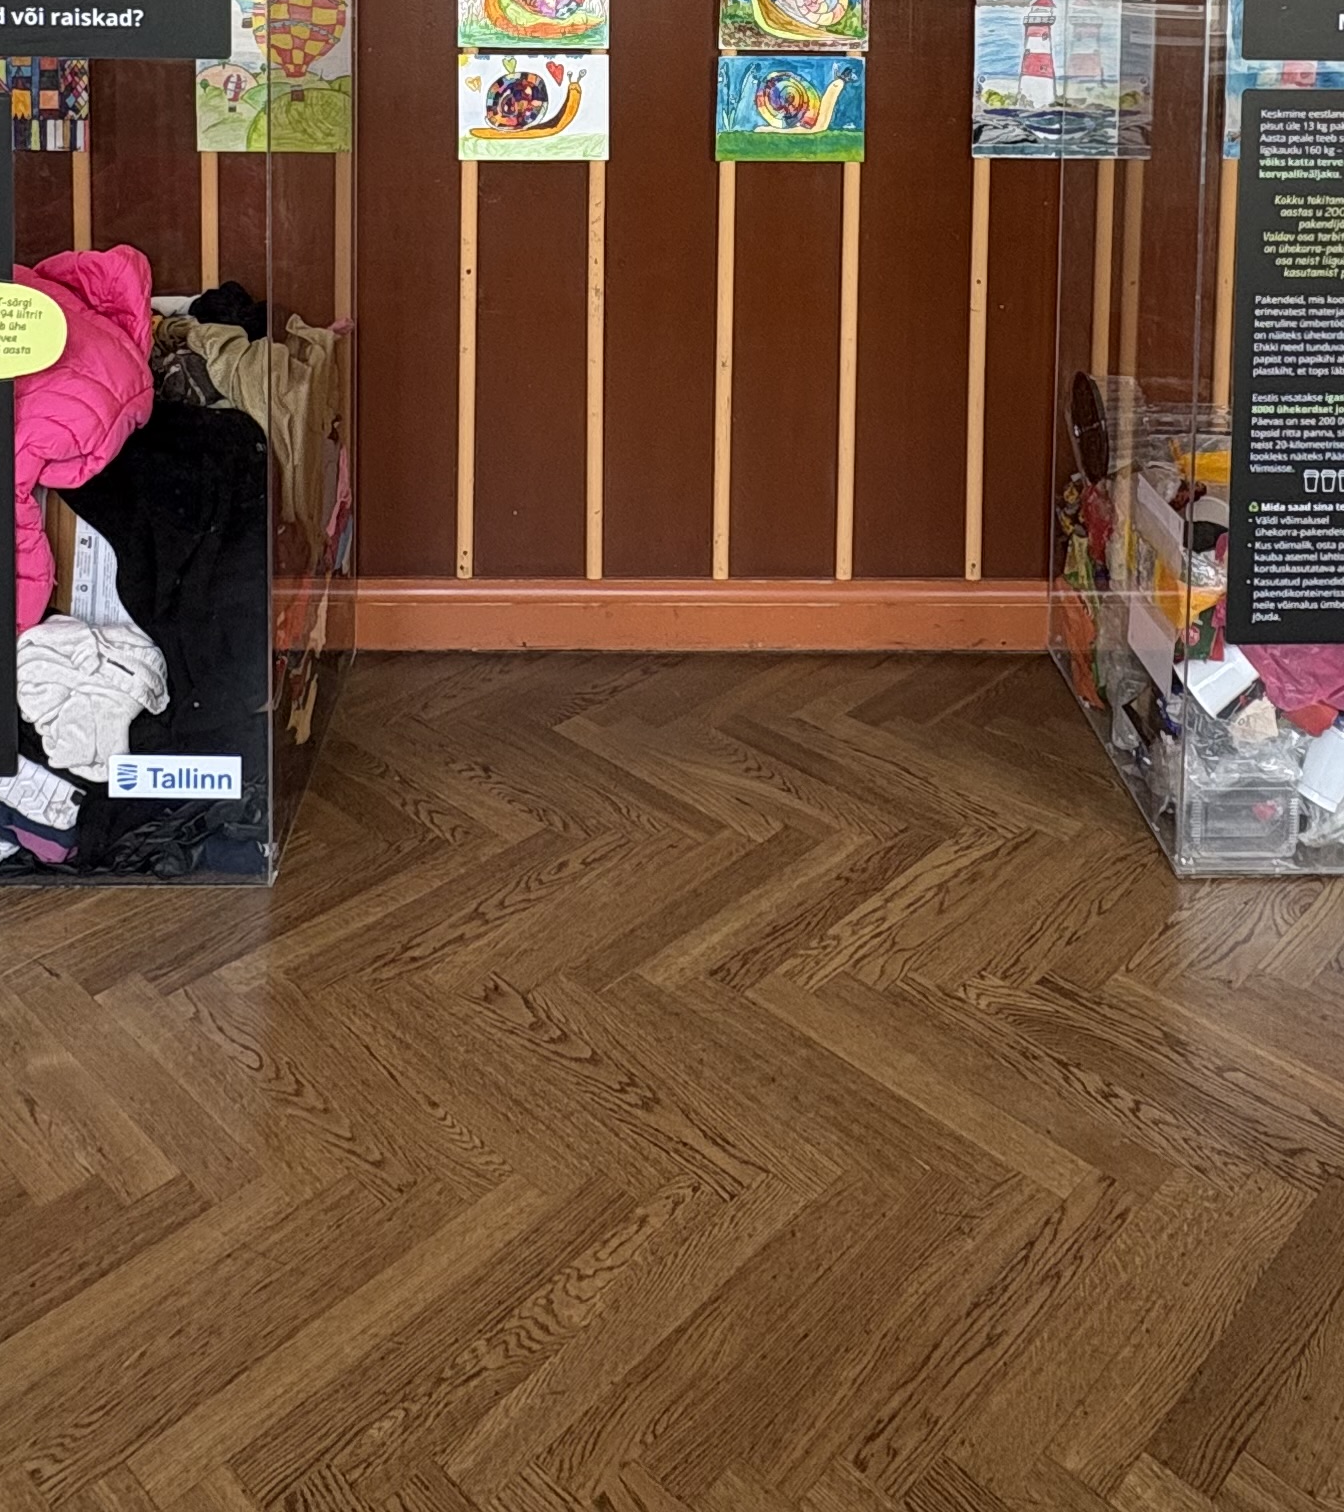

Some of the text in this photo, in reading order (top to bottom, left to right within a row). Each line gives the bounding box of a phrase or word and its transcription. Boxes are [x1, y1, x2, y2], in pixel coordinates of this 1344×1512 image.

[11, 8, 45, 26] või
[51, 8, 144, 27] raiskad?
[1261, 110, 1306, 119] Keskmine
[1304, 122, 1314, 130] 13
[1316, 122, 1327, 132] kg
[1260, 134, 1286, 142] Aasta
[1288, 134, 1314, 144] peale
[1316, 134, 1337, 142] teeb
[1305, 146, 1321, 154] 160
[1323, 146, 1335, 156] kg
[1260, 158, 1344, 167] võiks katta terve
[1275, 196, 1304, 205] Kokku
[1280, 208, 1313, 217] aastas
[16, 310, 42, 319] liitrit
[9, 323, 26, 331] ühe
[3, 346, 30, 355] aasta
[1261, 503, 1285, 511] Mida
[1288, 503, 1311, 511] saad
[1314, 503, 1333, 511] sina
[146, 766, 233, 791] Tallinn
